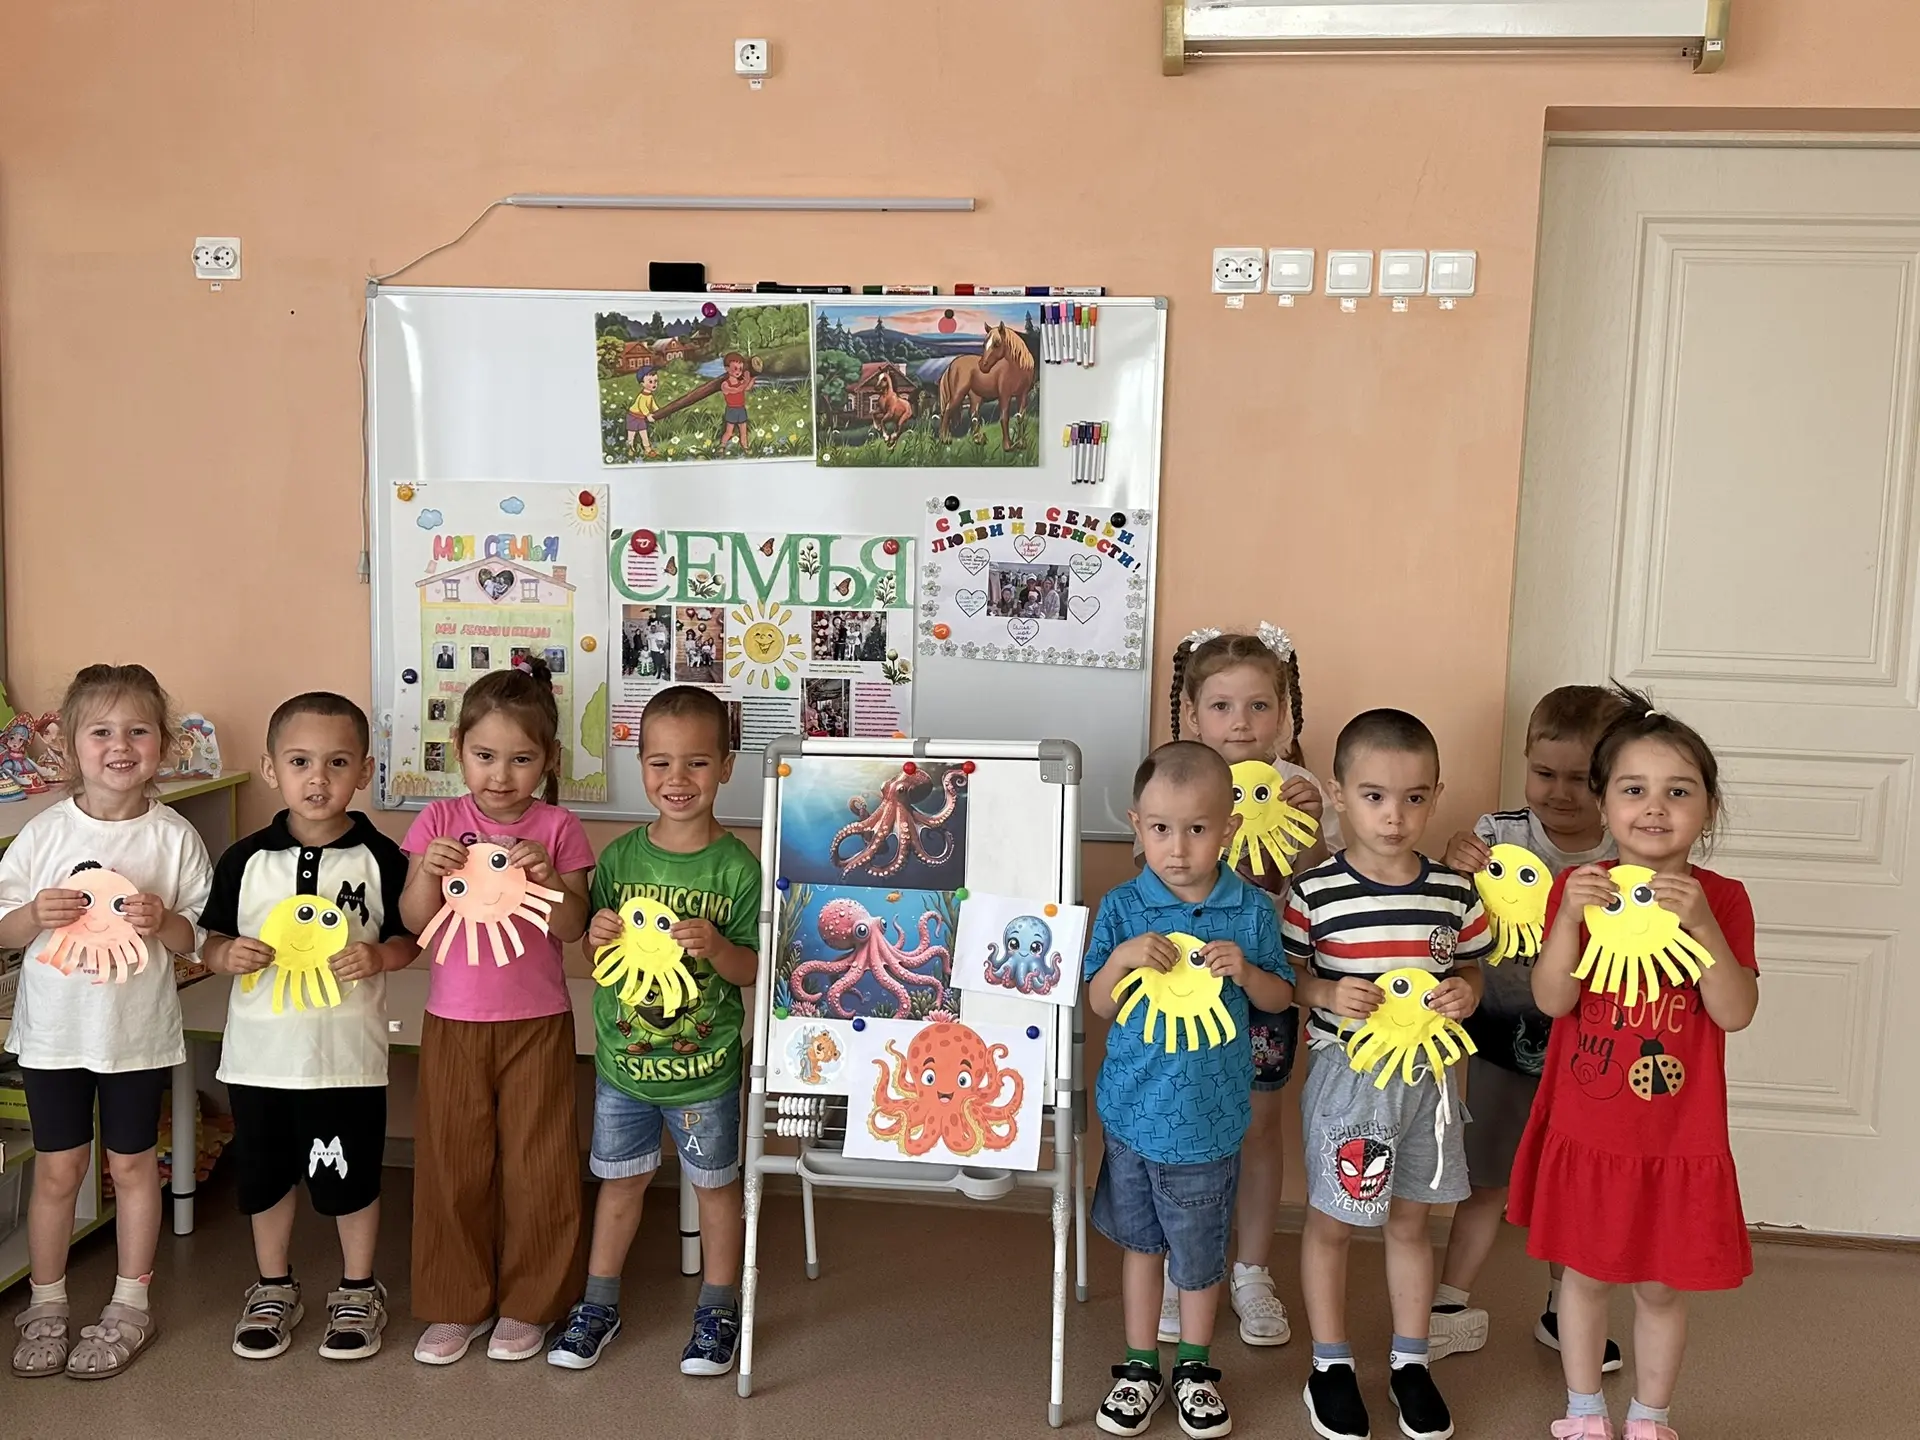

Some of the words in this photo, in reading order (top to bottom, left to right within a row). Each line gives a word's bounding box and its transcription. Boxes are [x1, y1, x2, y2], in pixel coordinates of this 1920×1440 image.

[936, 518, 950, 532] С
[958, 506, 1023, 527] ДНЕМ
[433, 534, 475, 561] МОЯ
[484, 533, 560, 562] СЕМЬЯ
[931, 523, 1004, 553] ЛЮБВИ
[1011, 522, 1025, 535] И
[1034, 522, 1142, 573] ВЕРНОСТИ!
[609, 529, 915, 609] СЕМЬЯ
[1330, 1193, 1389, 1219] VENOM
